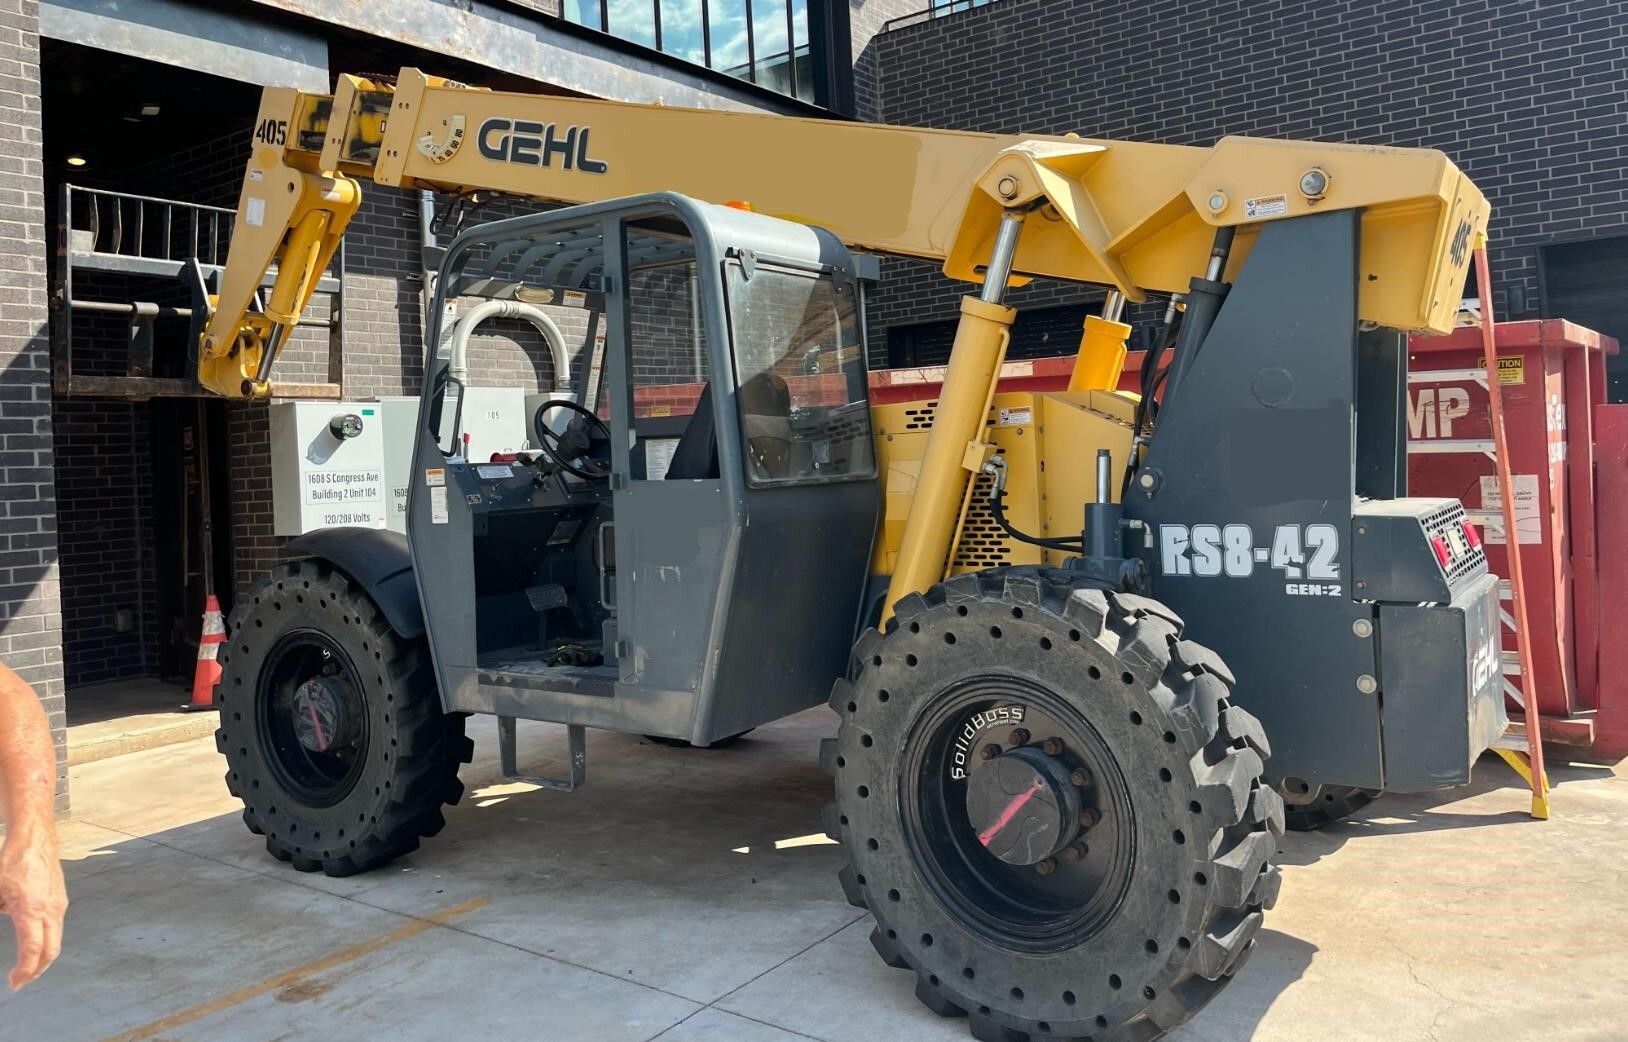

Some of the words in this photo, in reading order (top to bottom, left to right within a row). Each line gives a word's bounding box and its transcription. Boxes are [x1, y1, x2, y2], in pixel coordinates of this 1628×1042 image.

[256, 119, 287, 146] 405
[476, 116, 608, 175] GEHL
[1450, 218, 1472, 269] 405
[1482, 359, 1521, 368] CTION
[487, 411, 501, 419] 105
[308, 474, 325, 484] 1608
[326, 473, 332, 483] S
[332, 473, 365, 484] Congress
[366, 472, 379, 482] Ave
[312, 489, 343, 500] Building
[343, 488, 349, 498] 2
[349, 487, 364, 497] Unit
[364, 488, 377, 497] 104
[324, 514, 352, 525] 120/208
[353, 513, 371, 522] Volts
[1159, 523, 1341, 580] RS8-42
[1285, 583, 1342, 597] GEN:2
